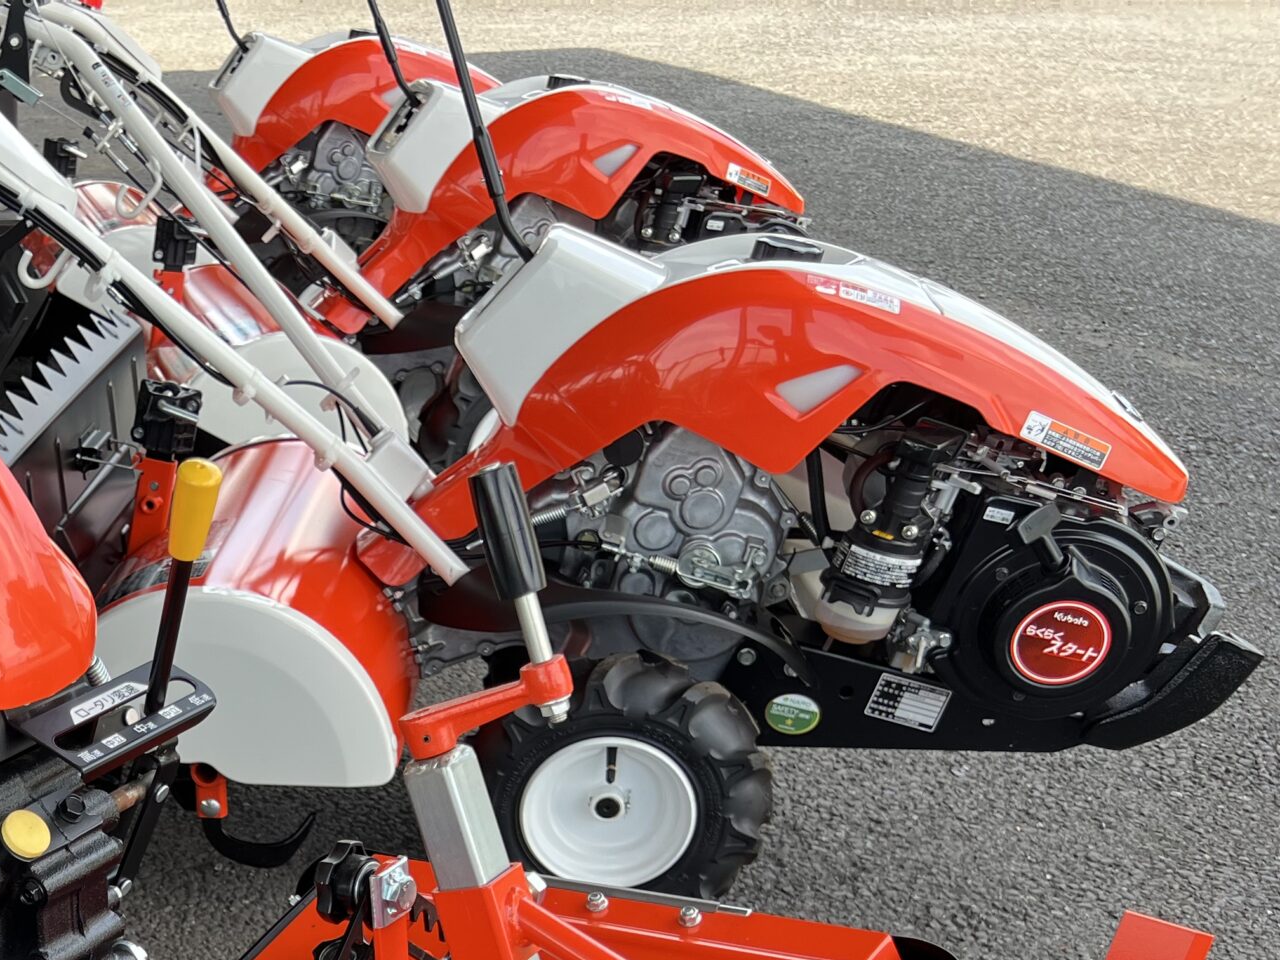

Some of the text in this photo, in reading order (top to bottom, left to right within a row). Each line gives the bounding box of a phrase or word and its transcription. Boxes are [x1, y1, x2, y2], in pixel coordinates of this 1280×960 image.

[1053, 611, 1089, 627] Kubota
[1026, 624, 1065, 642] らくらく
[1042, 640, 1098, 662] スタート
[75, 683, 140, 718] ロータリ変速
